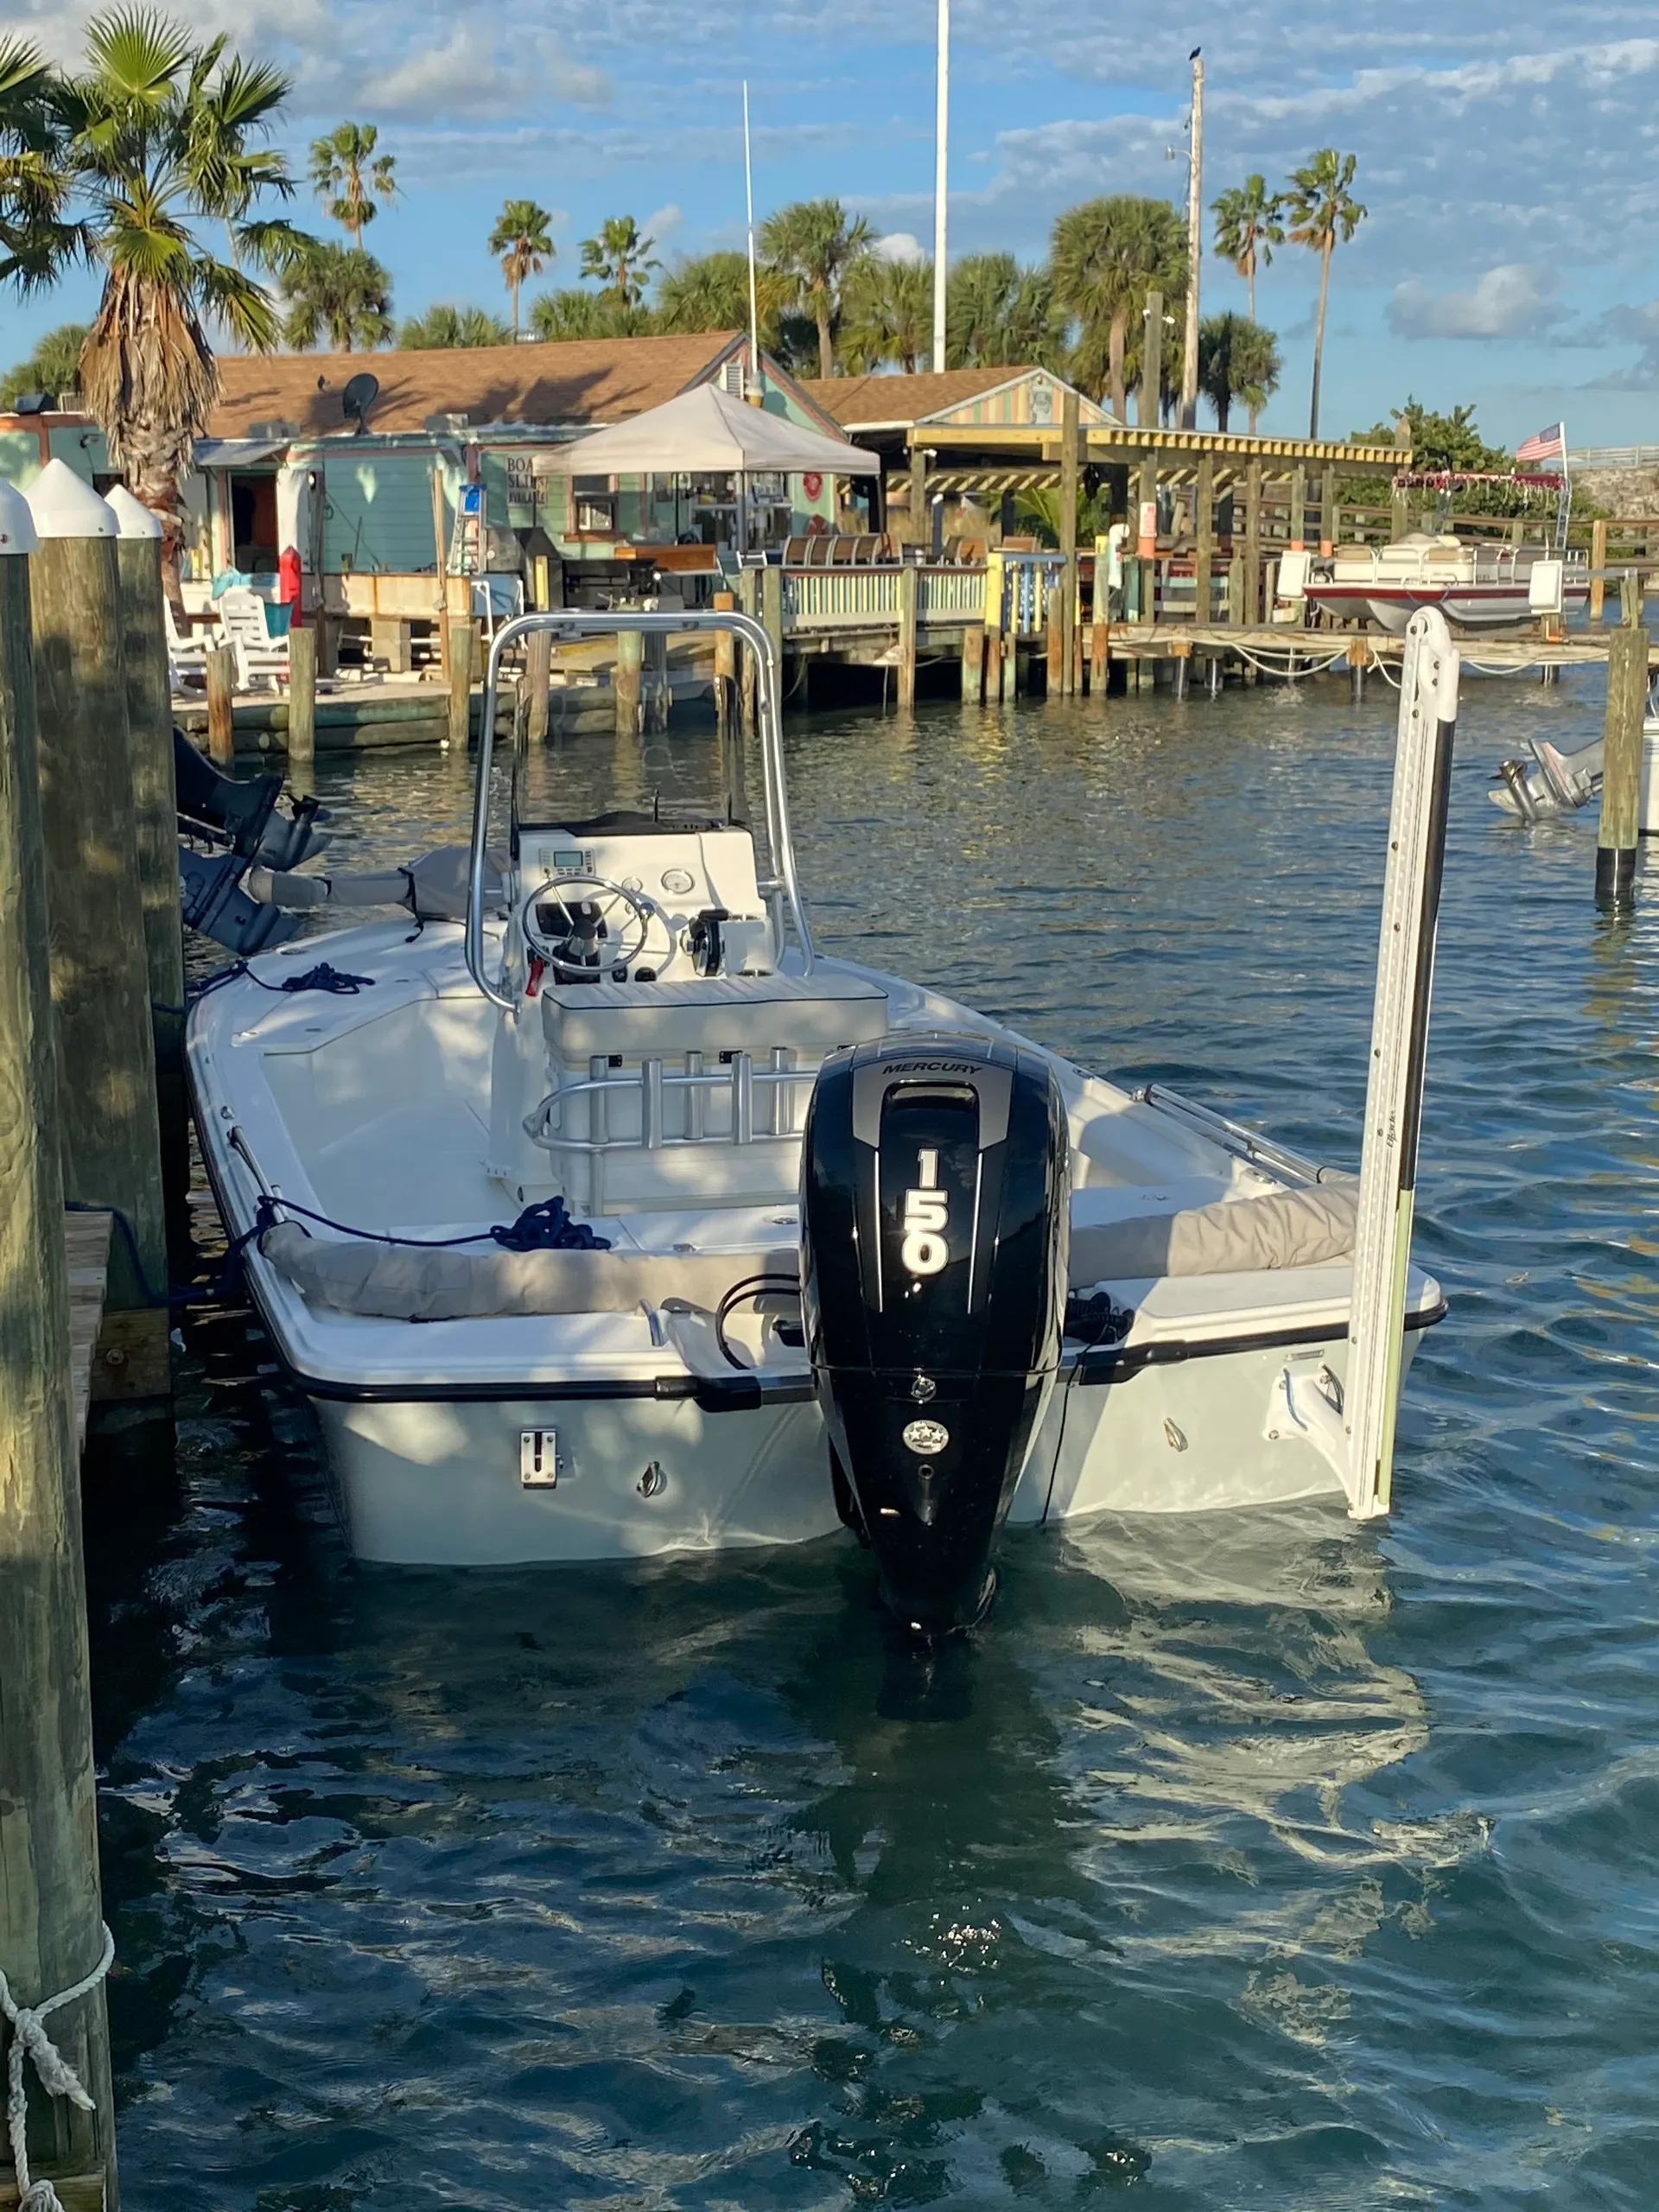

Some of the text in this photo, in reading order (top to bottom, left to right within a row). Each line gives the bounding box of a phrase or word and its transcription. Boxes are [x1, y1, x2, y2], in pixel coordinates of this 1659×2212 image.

[507, 457, 533, 473] BOA
[508, 490, 546, 504] AVAILALE
[882, 1061, 984, 1075] MERCURY
[901, 1147, 949, 1275] 150
